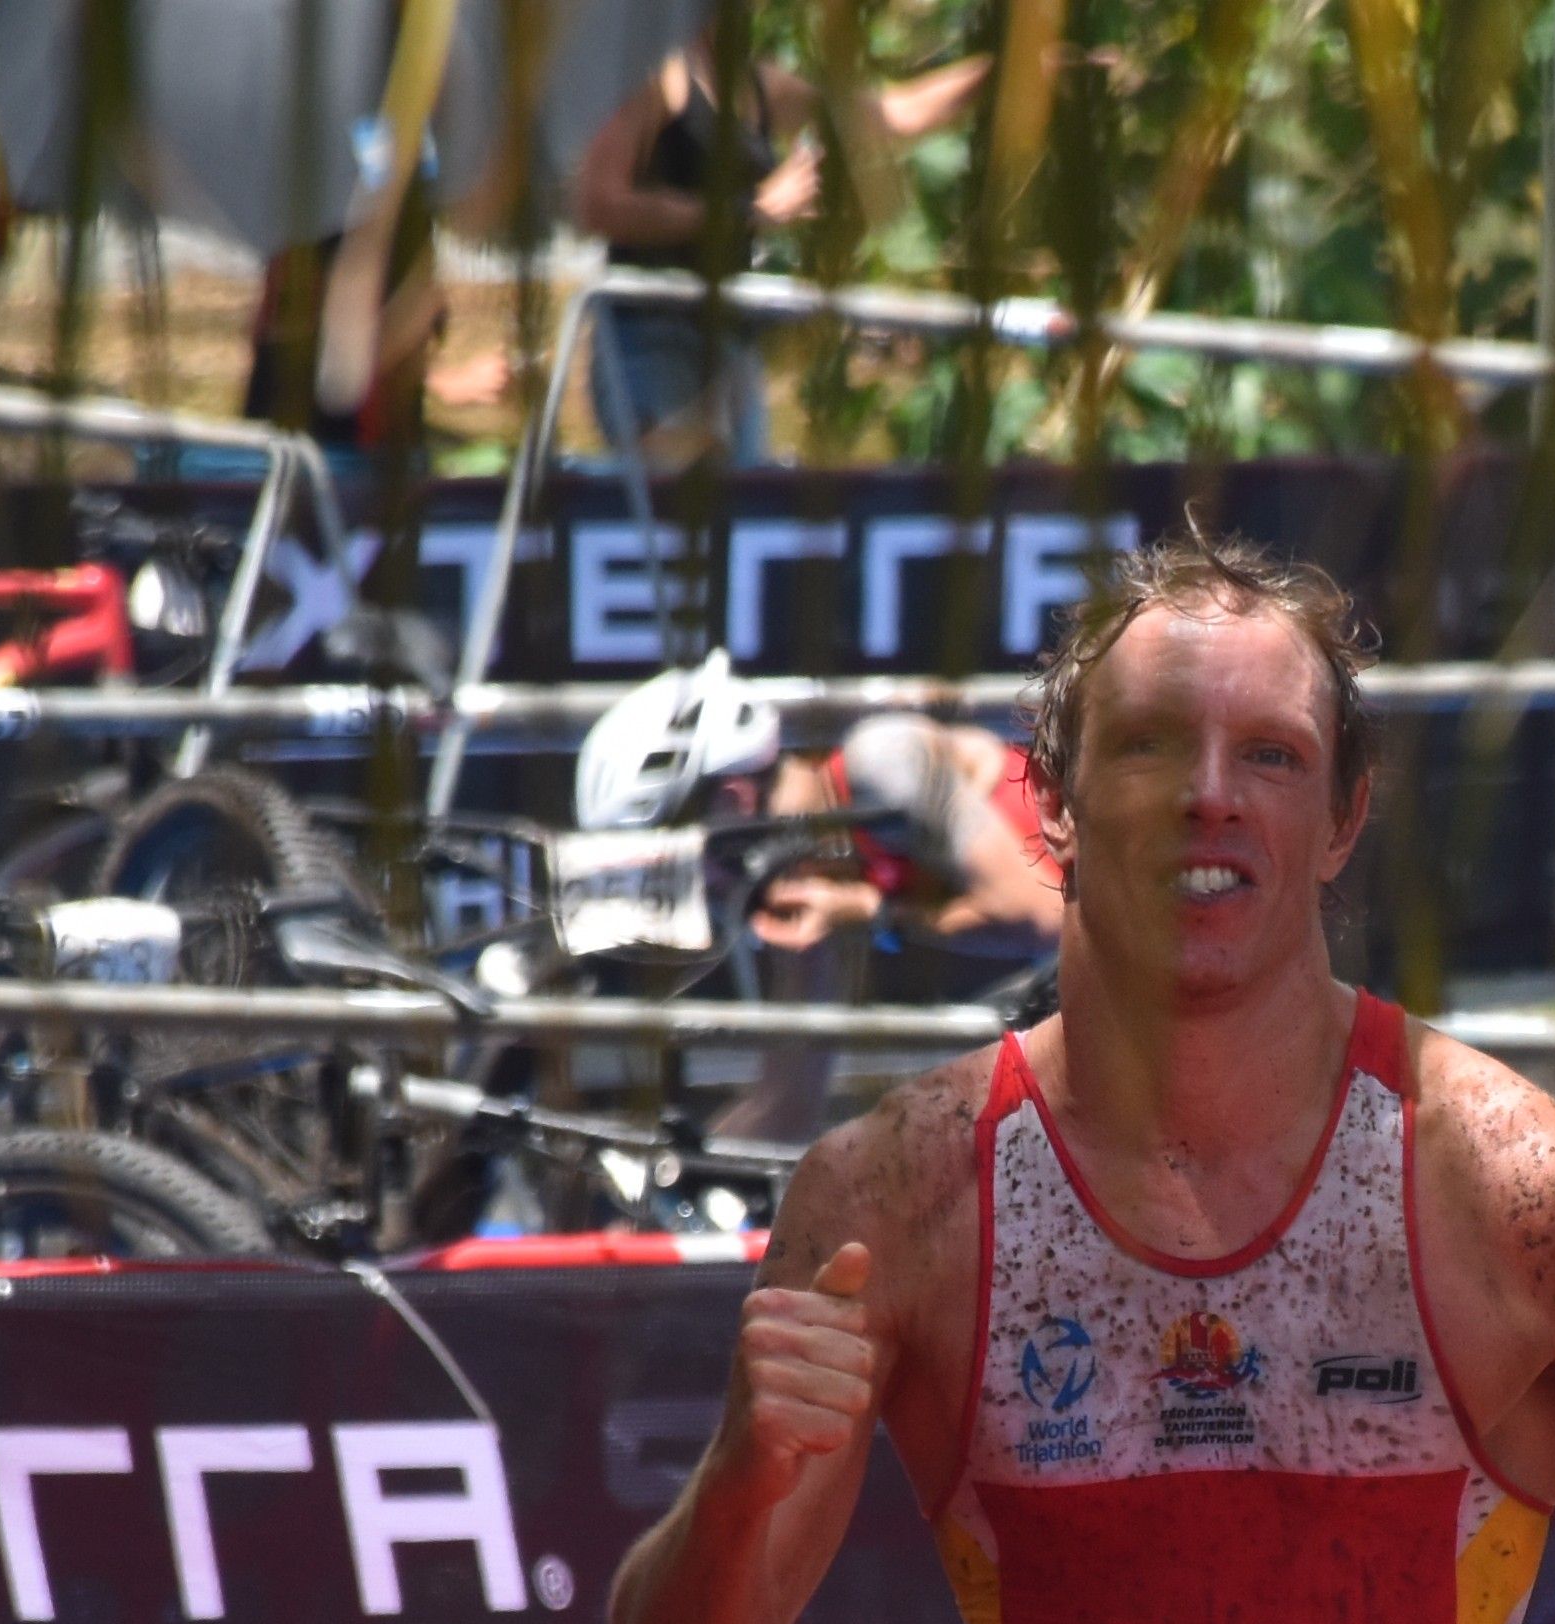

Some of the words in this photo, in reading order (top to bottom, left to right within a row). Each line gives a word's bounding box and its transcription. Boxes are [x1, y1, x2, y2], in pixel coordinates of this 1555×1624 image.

[1315, 1359, 1418, 1396] poli
[1027, 1415, 1088, 1440] World
[1015, 1439, 1102, 1463] Triathlon
[1155, 1437, 1174, 1447] DE
[1179, 1433, 1255, 1446] TRIATHLON
